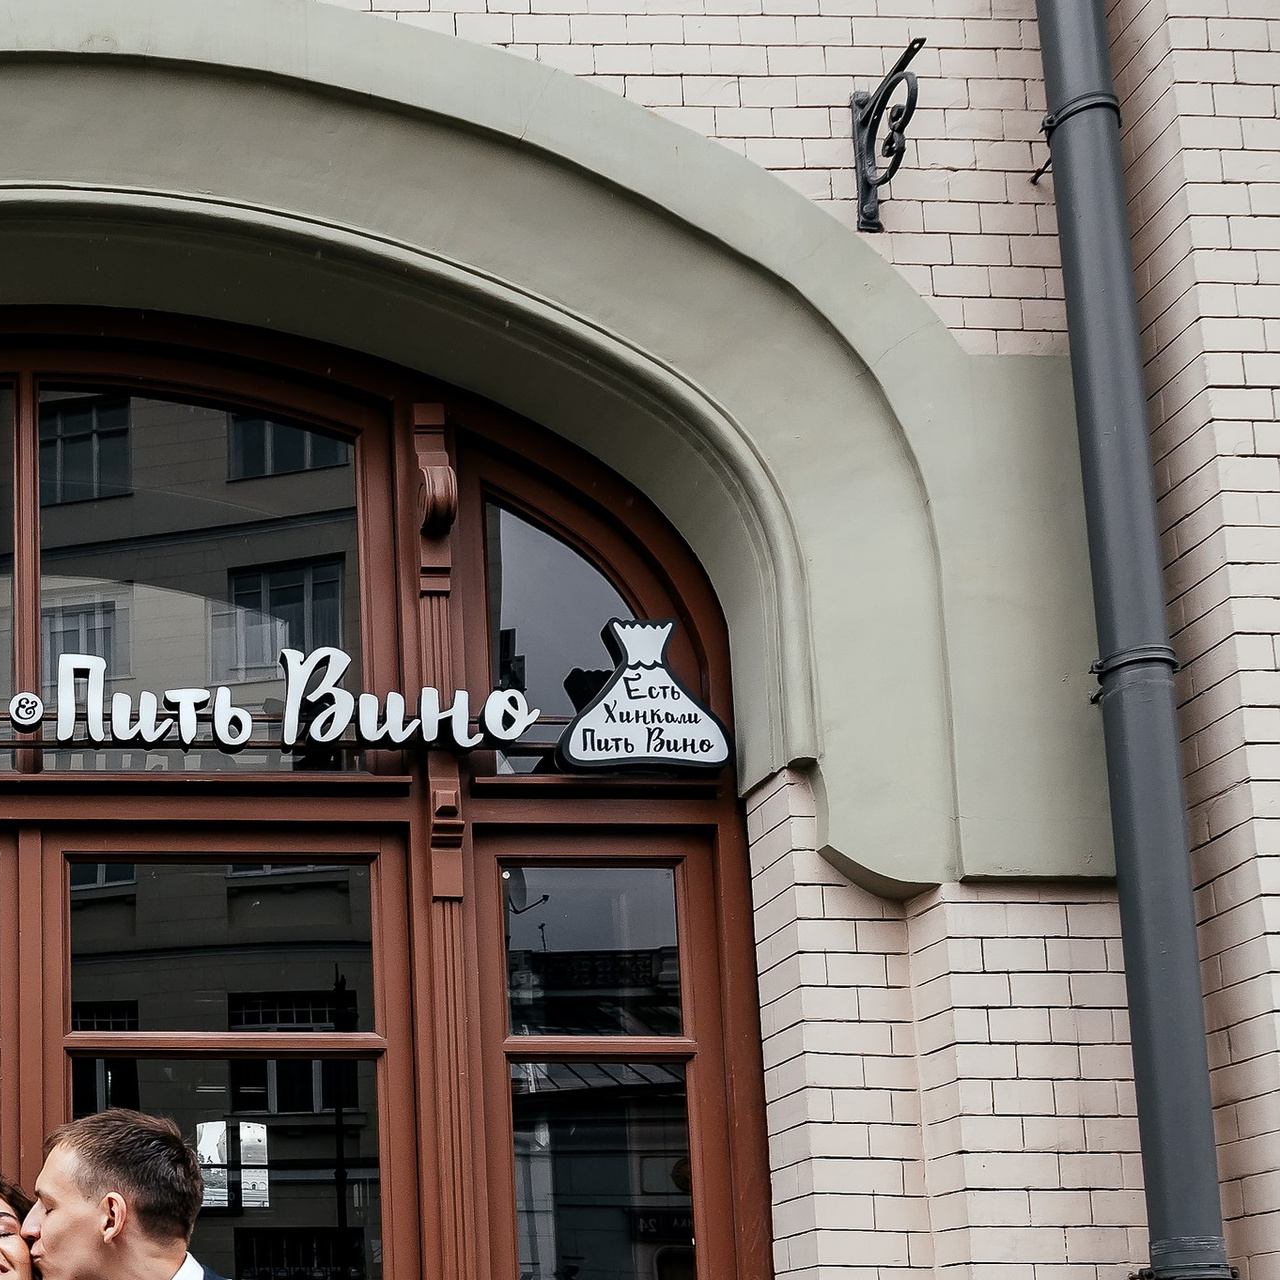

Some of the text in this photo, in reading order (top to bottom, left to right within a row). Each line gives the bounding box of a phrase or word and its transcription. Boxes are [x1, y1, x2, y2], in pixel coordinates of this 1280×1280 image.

[56, 653, 253, 746] Пить
[280, 646, 541, 749] Вино
[623, 672, 681, 701] Есть
[603, 699, 702, 725] Хинкали
[582, 726, 715, 755] Пить Вино
